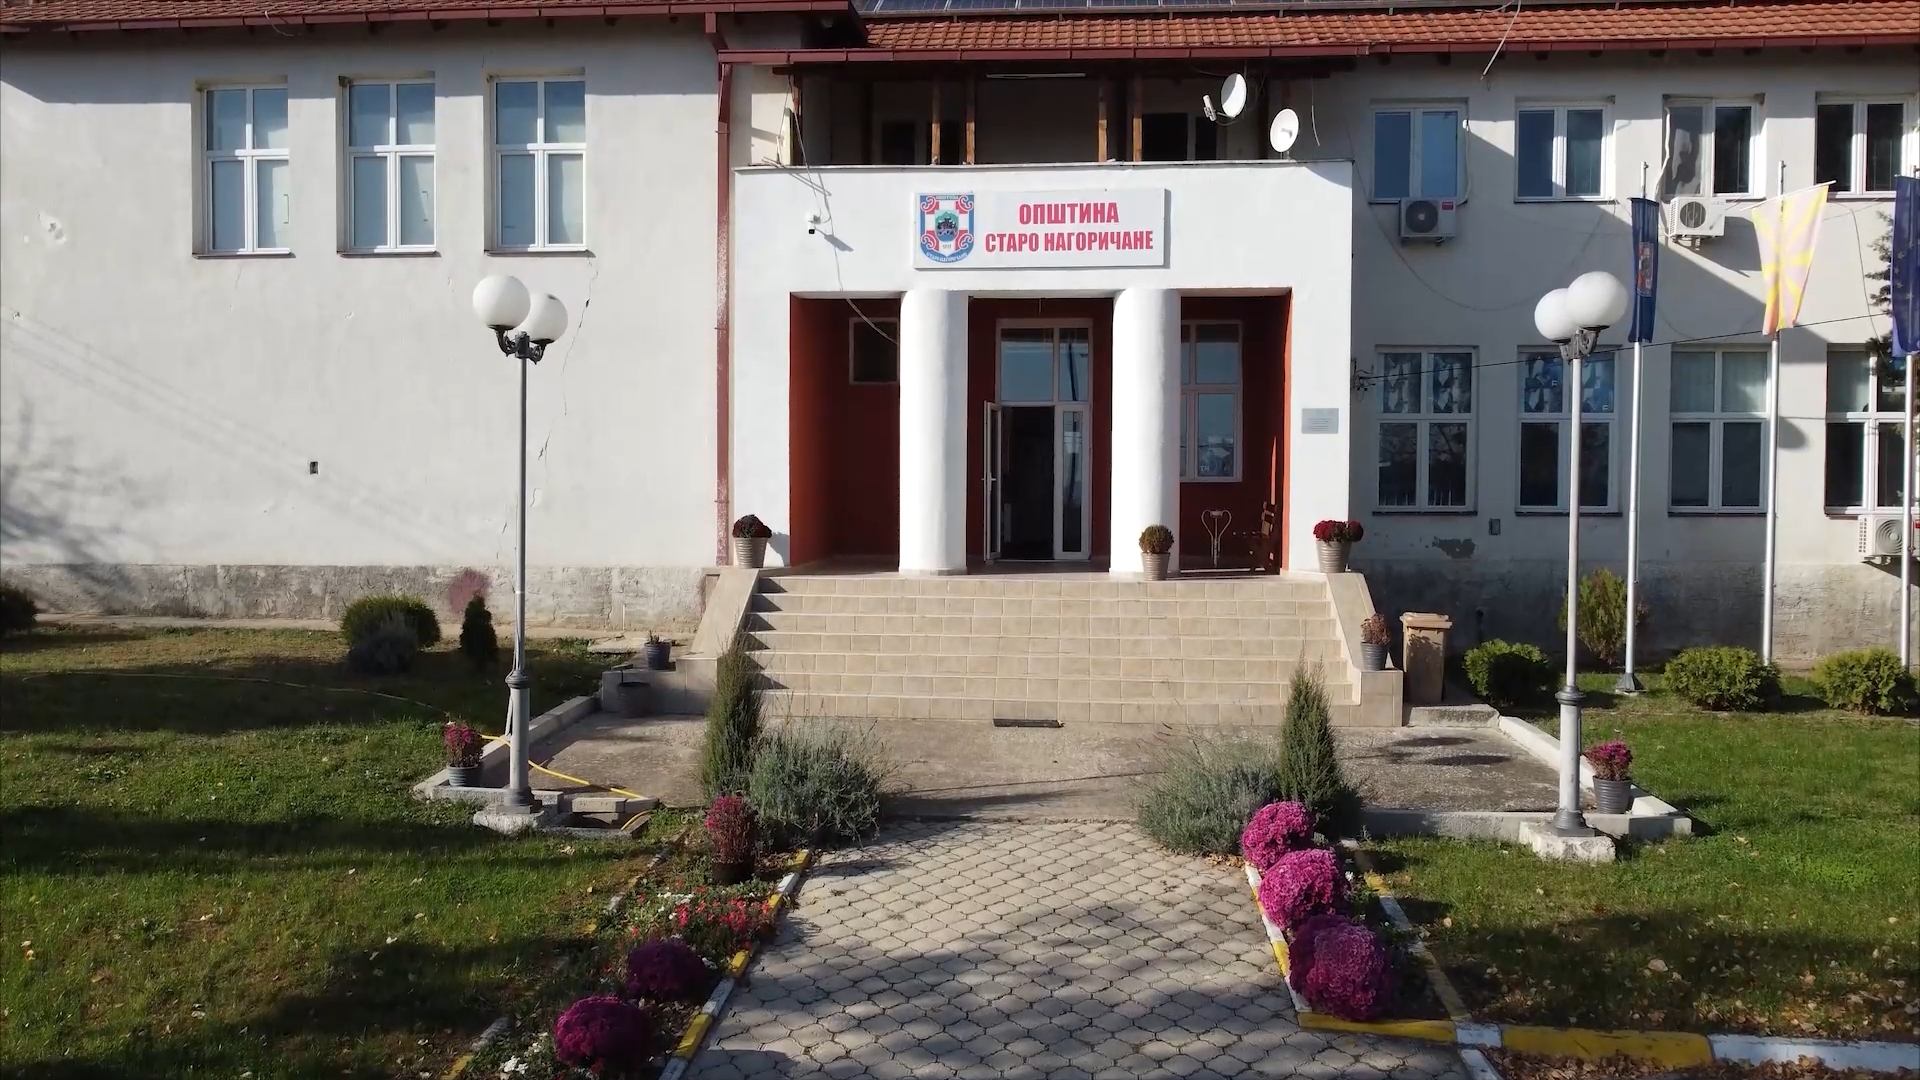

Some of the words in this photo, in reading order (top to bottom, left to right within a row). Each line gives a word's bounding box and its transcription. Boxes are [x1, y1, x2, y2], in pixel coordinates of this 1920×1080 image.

[1019, 202, 1118, 224] ОПШТИНА
[985, 233, 1038, 252] СТАРО
[1044, 231, 1153, 251] НАГОРИЧАНЕ
